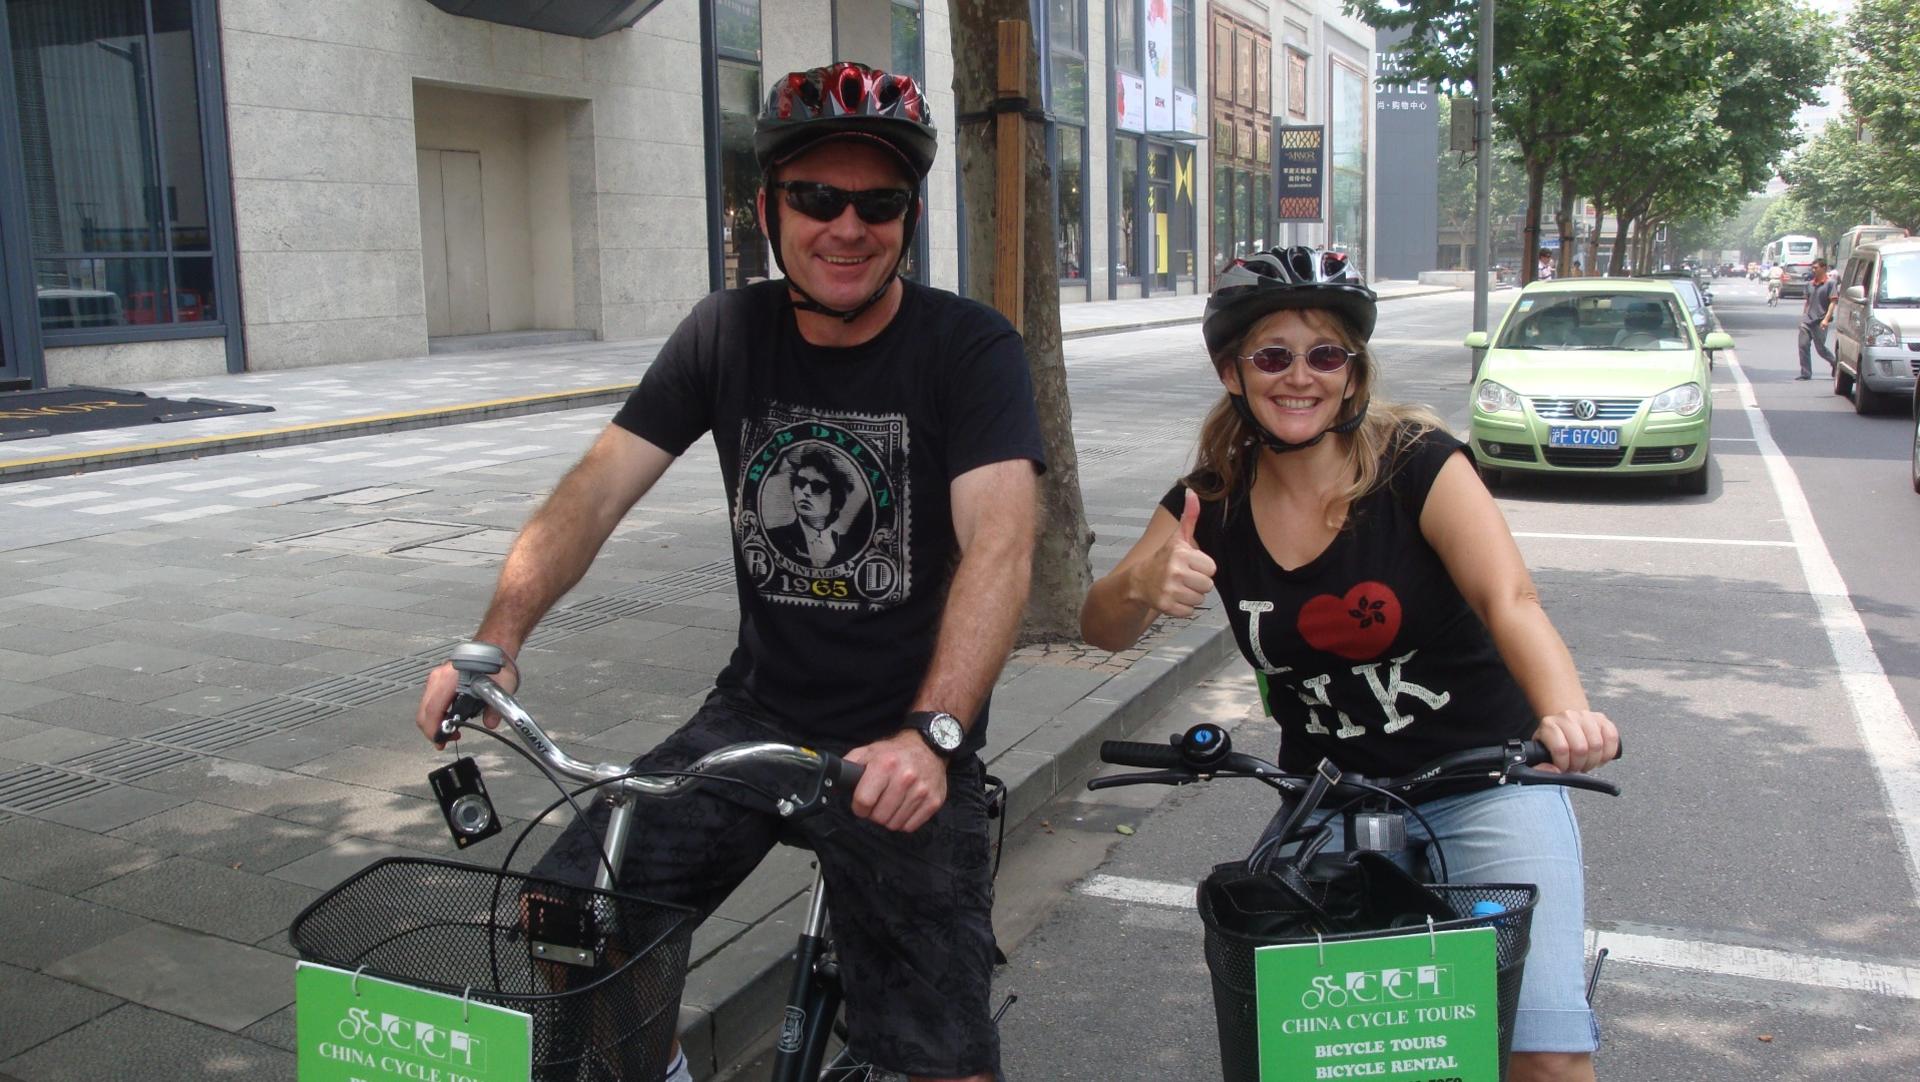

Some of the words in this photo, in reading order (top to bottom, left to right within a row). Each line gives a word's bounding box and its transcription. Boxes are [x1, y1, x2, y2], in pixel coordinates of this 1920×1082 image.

[1572, 429, 1617, 445] G7900
[784, 558, 841, 578] VINTAGE
[866, 562, 892, 591] D
[780, 574, 848, 598] 1965
[1281, 1017, 1341, 1034] CHINA
[1347, 1010, 1409, 1029] CYCLE
[1415, 1004, 1476, 1023] TOURS
[1315, 1041, 1385, 1058] BICYCLE
[1390, 1035, 1447, 1052] TOURS
[318, 1042, 376, 1068] CHINA
[381, 1056, 441, 1082] CYCLE
[1316, 1062, 1386, 1079] BICYCLE
[1391, 1056, 1458, 1073] RENTAL
